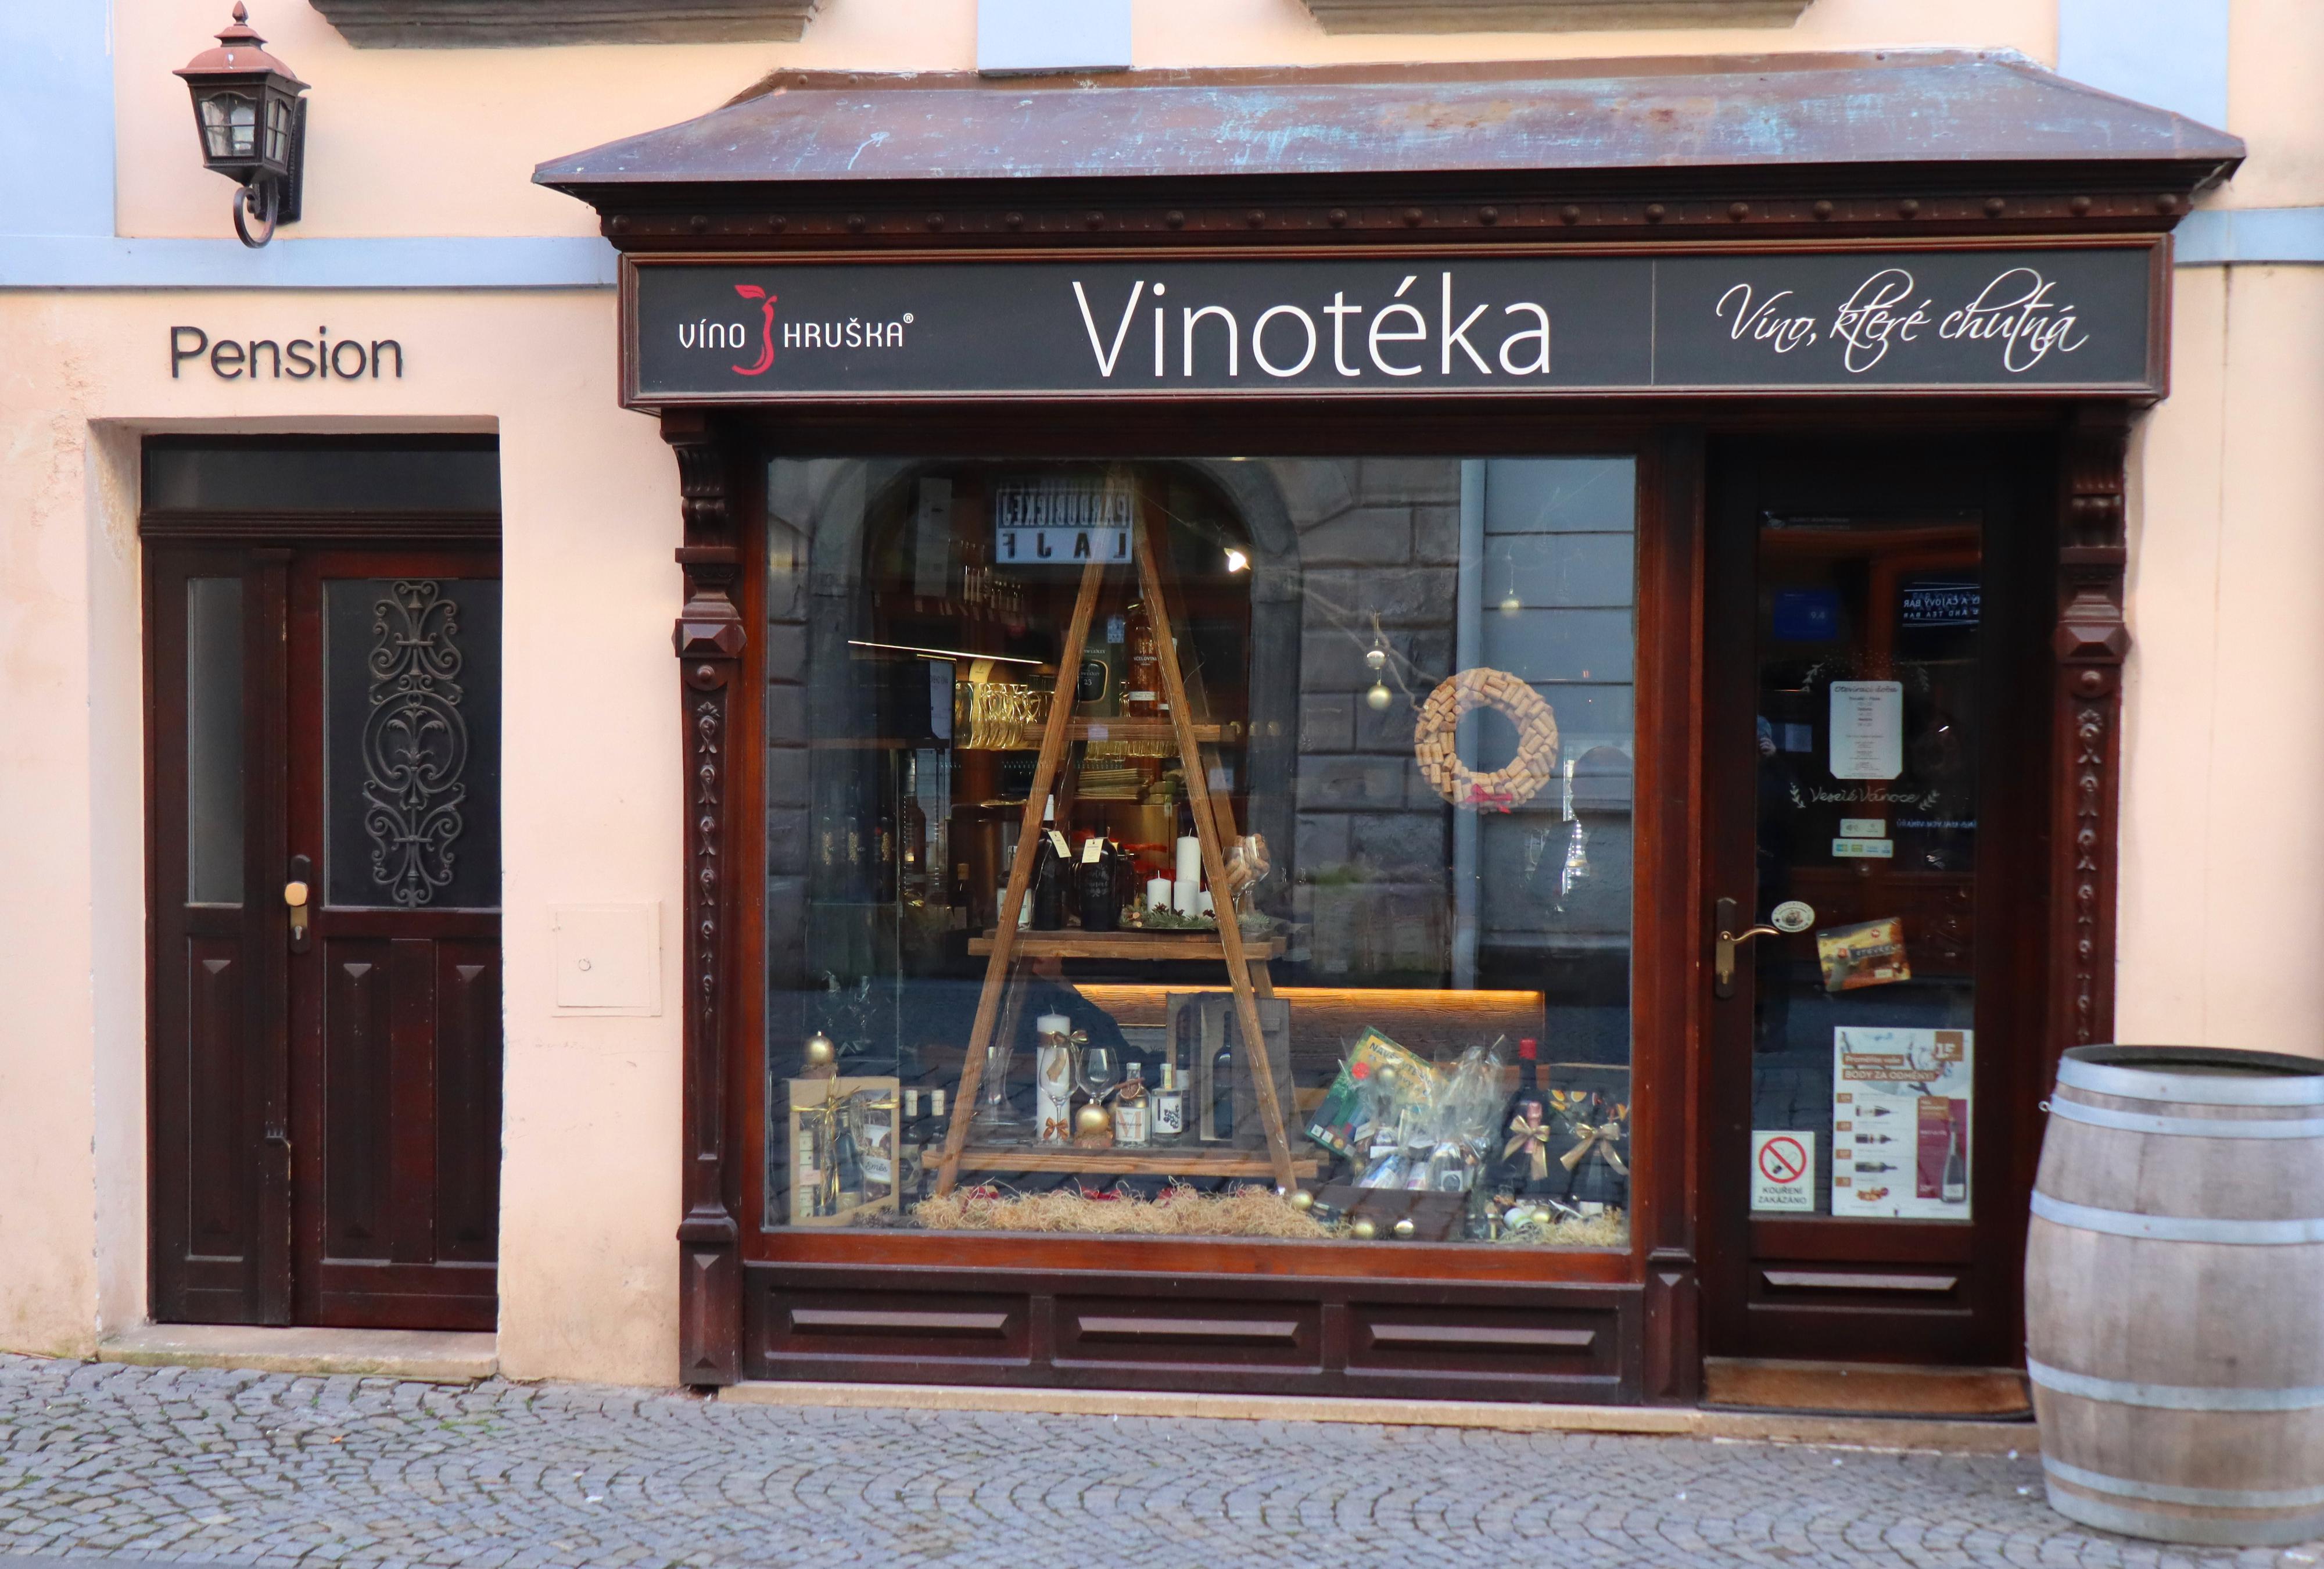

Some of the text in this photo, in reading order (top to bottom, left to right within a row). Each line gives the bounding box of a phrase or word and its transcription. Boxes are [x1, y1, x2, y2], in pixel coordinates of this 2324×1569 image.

[1072, 271, 1550, 377] Vinotéka
[1716, 268, 2089, 372] Víno, které chutná
[679, 318, 745, 349] VÍNO
[171, 326, 403, 379] Pension
[1809, 786, 1920, 803] Veselé Vánoce
[1845, 1070, 1872, 1079] BODY
[1875, 1071, 1888, 1079] ZA
[1758, 1196, 1807, 1205] ZAKÁZÁNO
[1762, 1185, 1803, 1194] KOUŘENÍ
